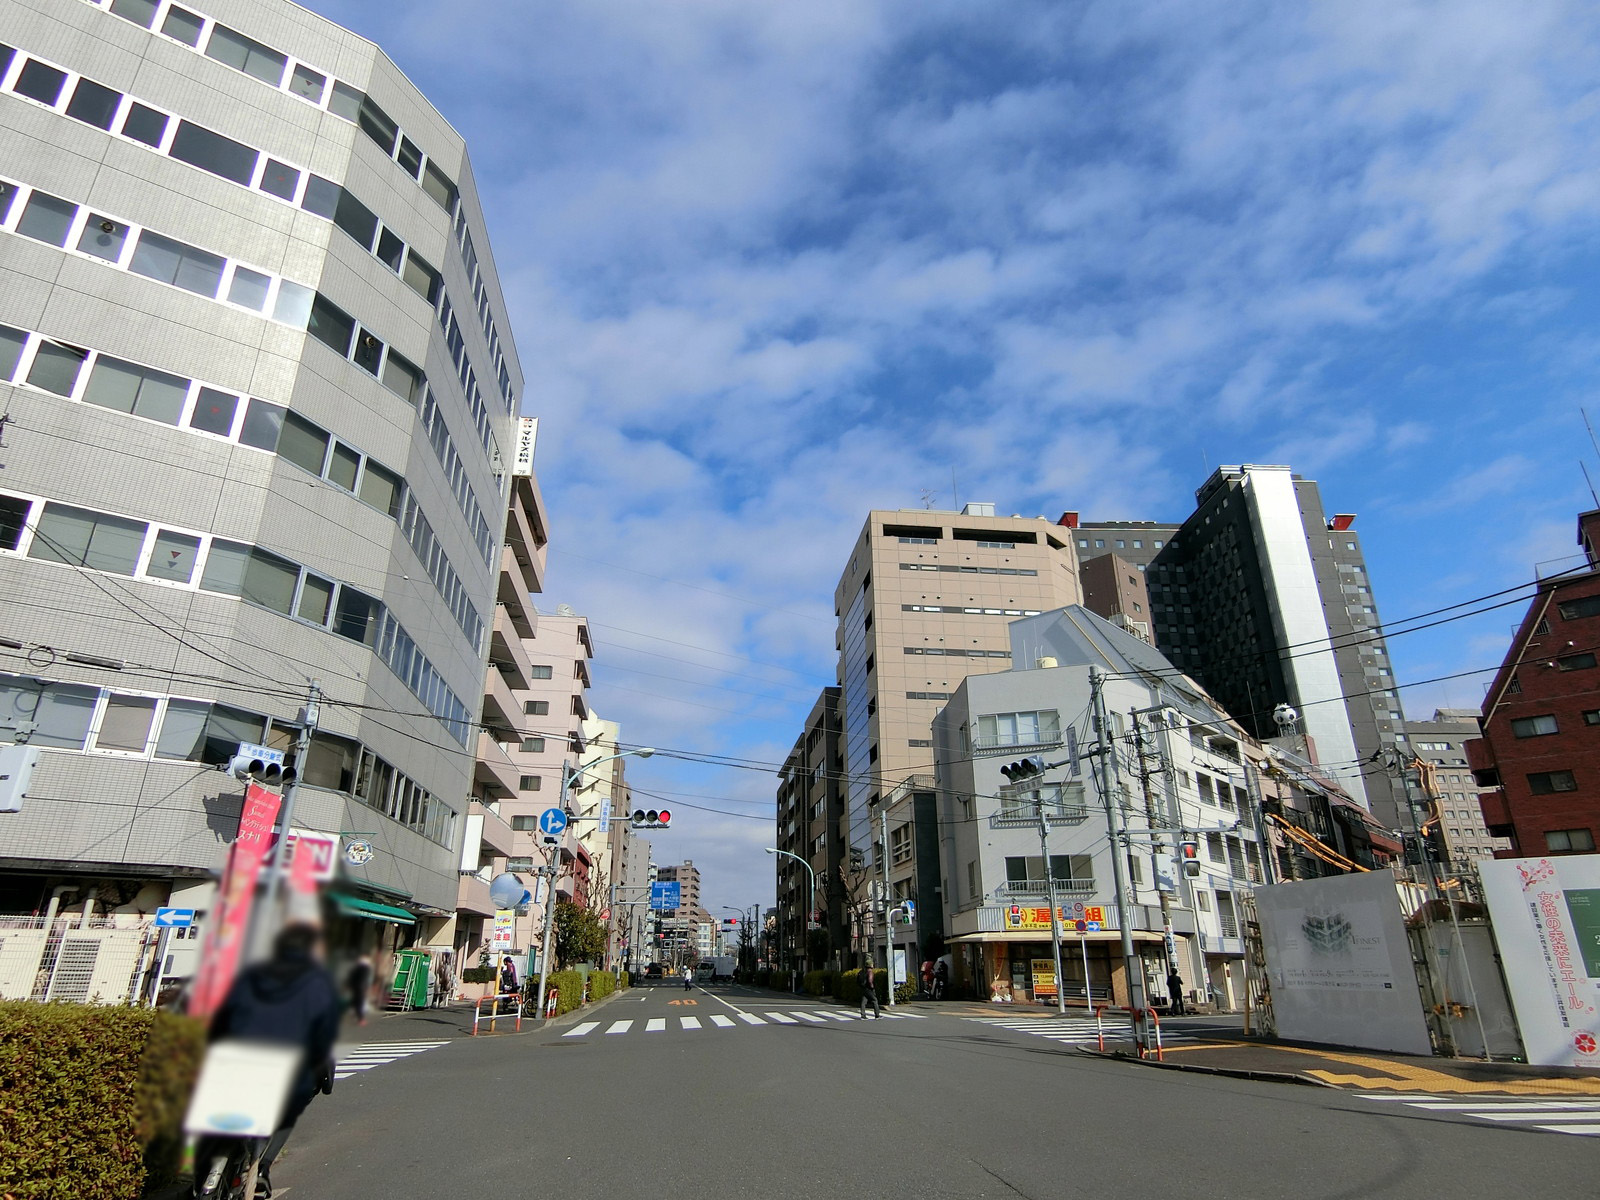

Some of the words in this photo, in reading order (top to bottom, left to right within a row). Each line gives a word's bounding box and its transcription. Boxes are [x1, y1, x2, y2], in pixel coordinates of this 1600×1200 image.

[1537, 891, 1584, 1010] 女性の未来にエール
[667, 999, 698, 1007] 40
